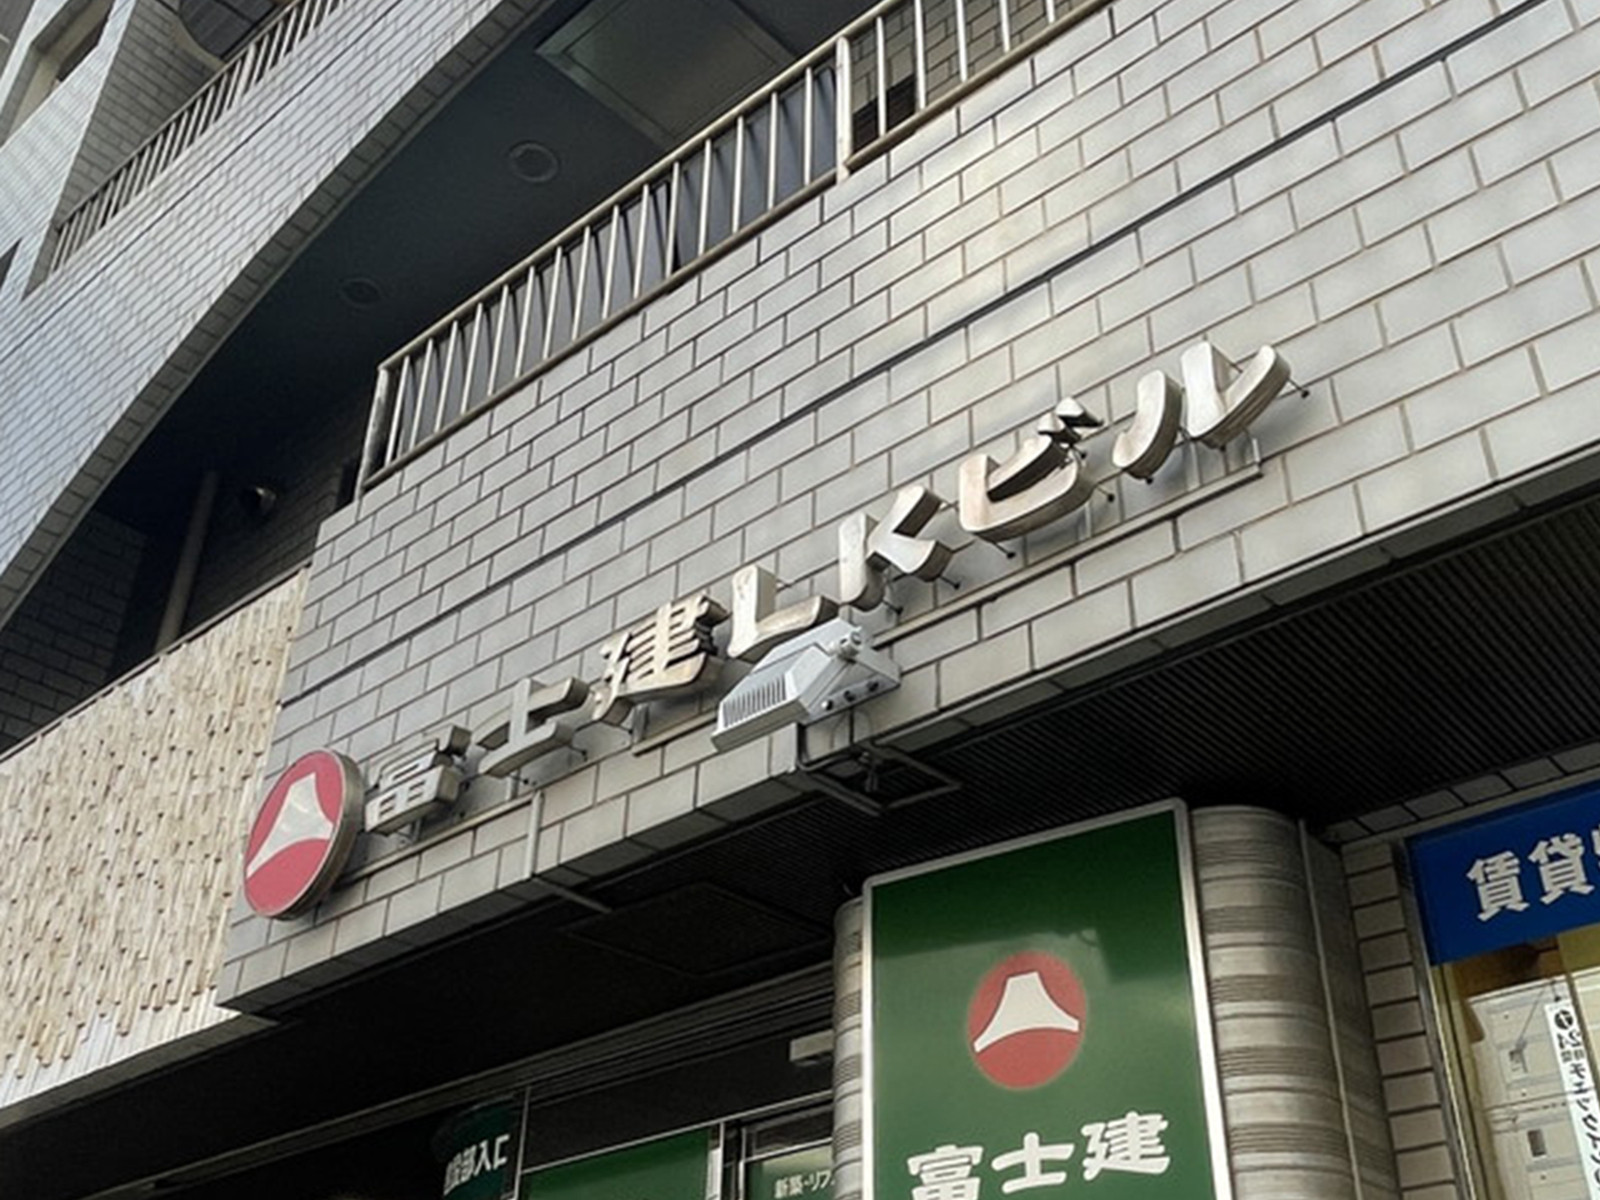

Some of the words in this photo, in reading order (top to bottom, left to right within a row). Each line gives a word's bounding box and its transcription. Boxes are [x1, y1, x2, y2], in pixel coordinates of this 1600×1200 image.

[1465, 822, 1600, 921] 賃貸
[906, 1110, 1171, 1200] 富士建
